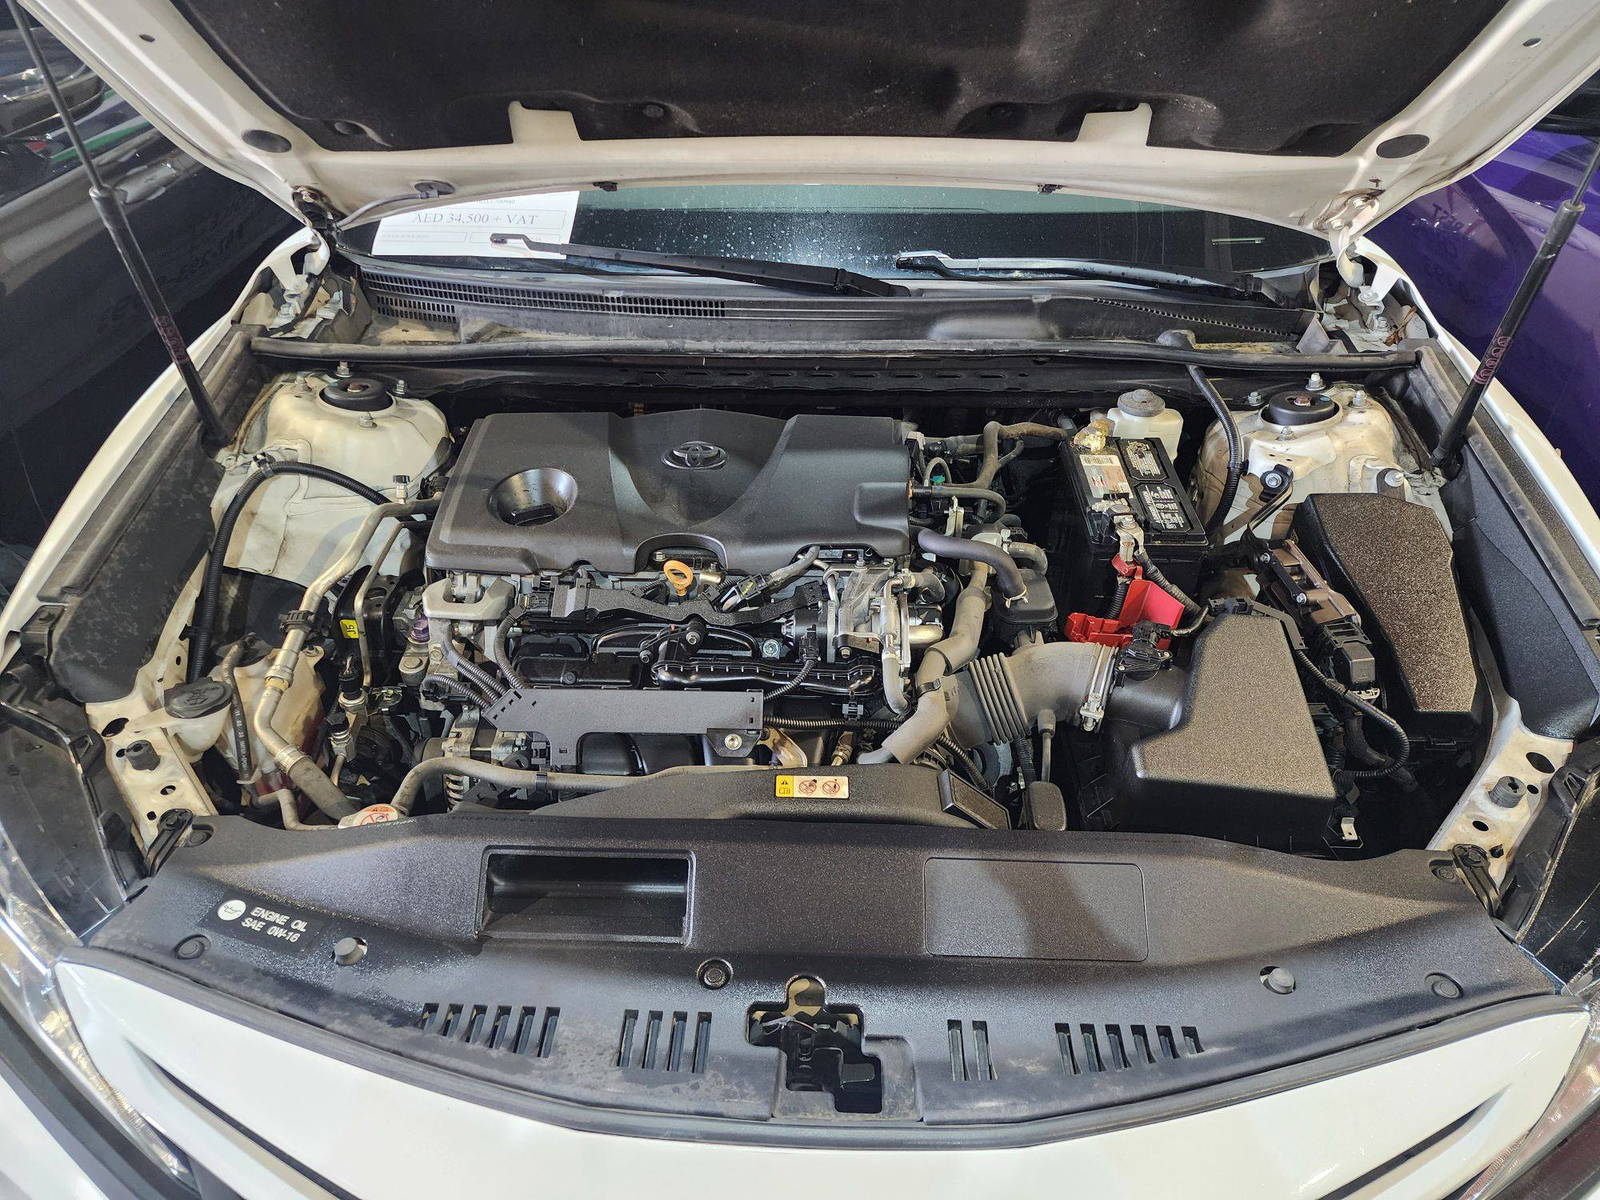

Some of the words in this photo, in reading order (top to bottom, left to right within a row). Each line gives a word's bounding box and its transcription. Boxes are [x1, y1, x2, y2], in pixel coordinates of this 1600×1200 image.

[413, 212, 443, 224] AED
[507, 214, 539, 225] VAT
[241, 917, 266, 931] SAE
[250, 907, 290, 925] ENGINE
[290, 919, 308, 932] OIL
